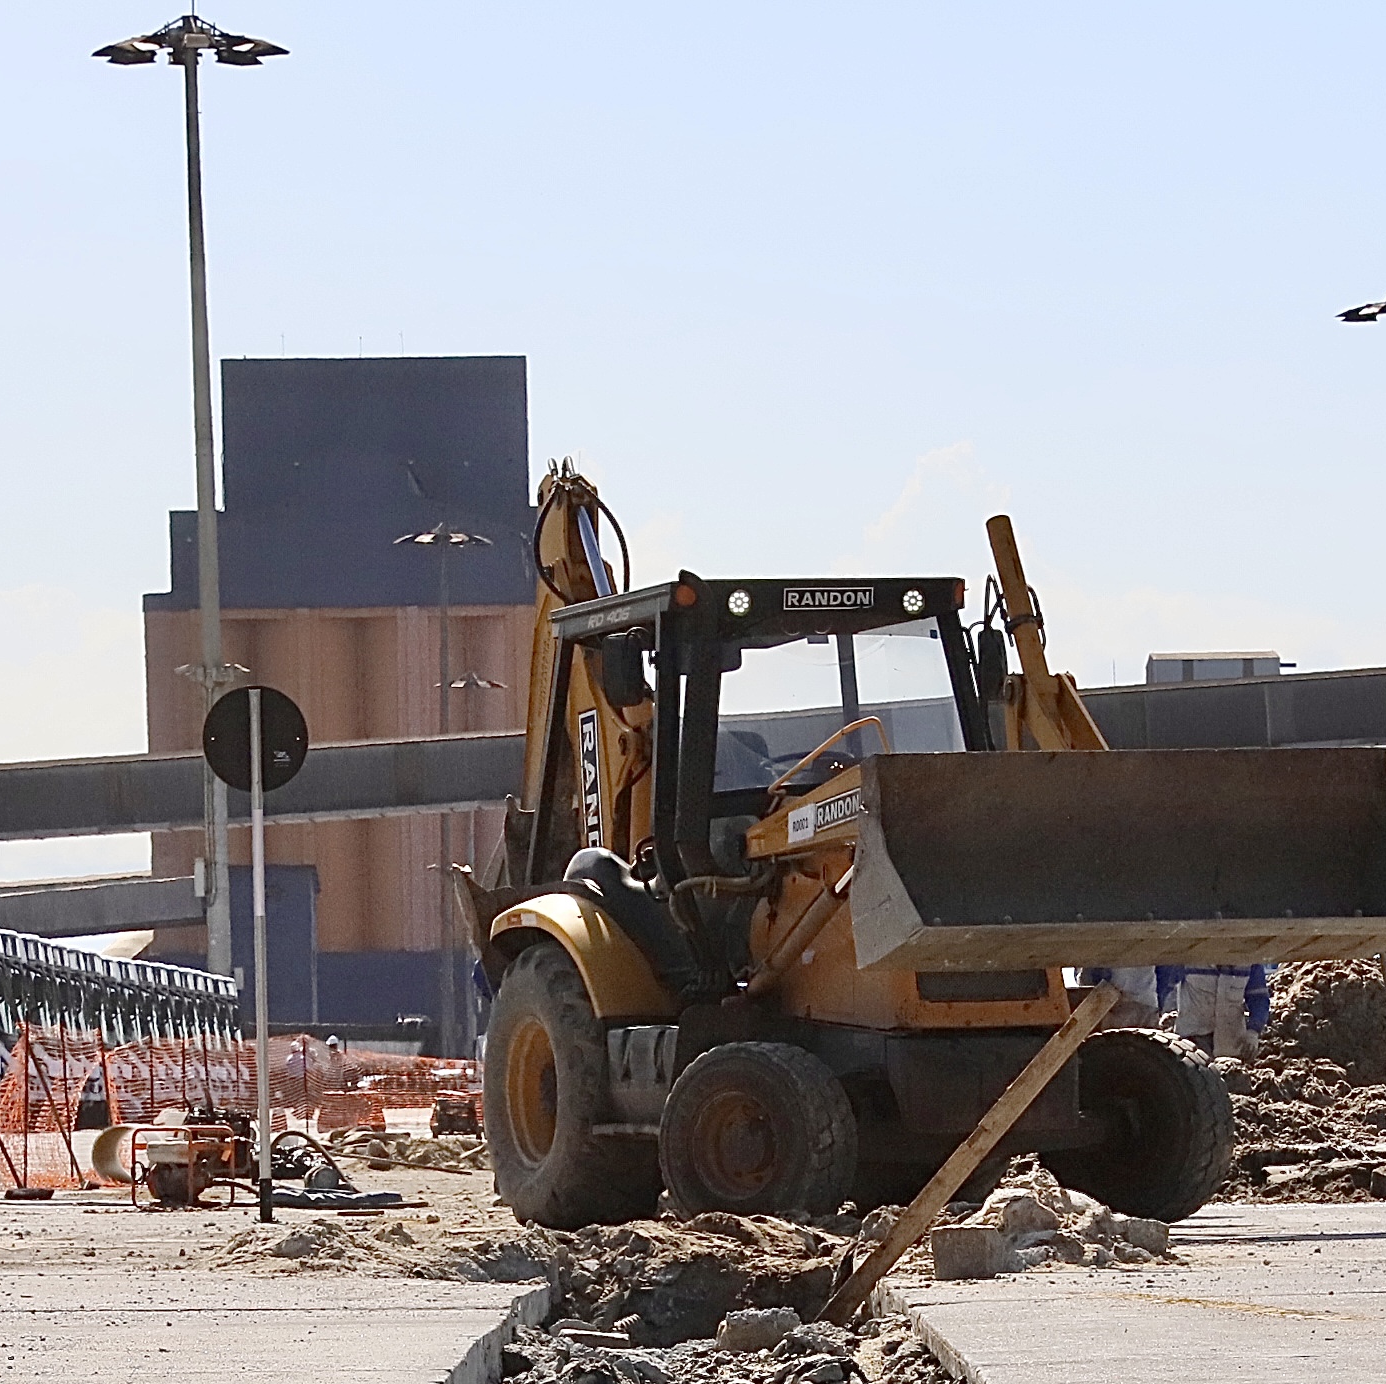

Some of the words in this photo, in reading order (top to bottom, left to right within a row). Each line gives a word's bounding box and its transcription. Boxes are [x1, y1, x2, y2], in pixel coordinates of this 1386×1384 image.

[787, 591, 870, 606] RANDON
[587, 613, 604, 629] RD
[581, 721, 601, 848] RAND
[817, 794, 860, 826] RANDON
